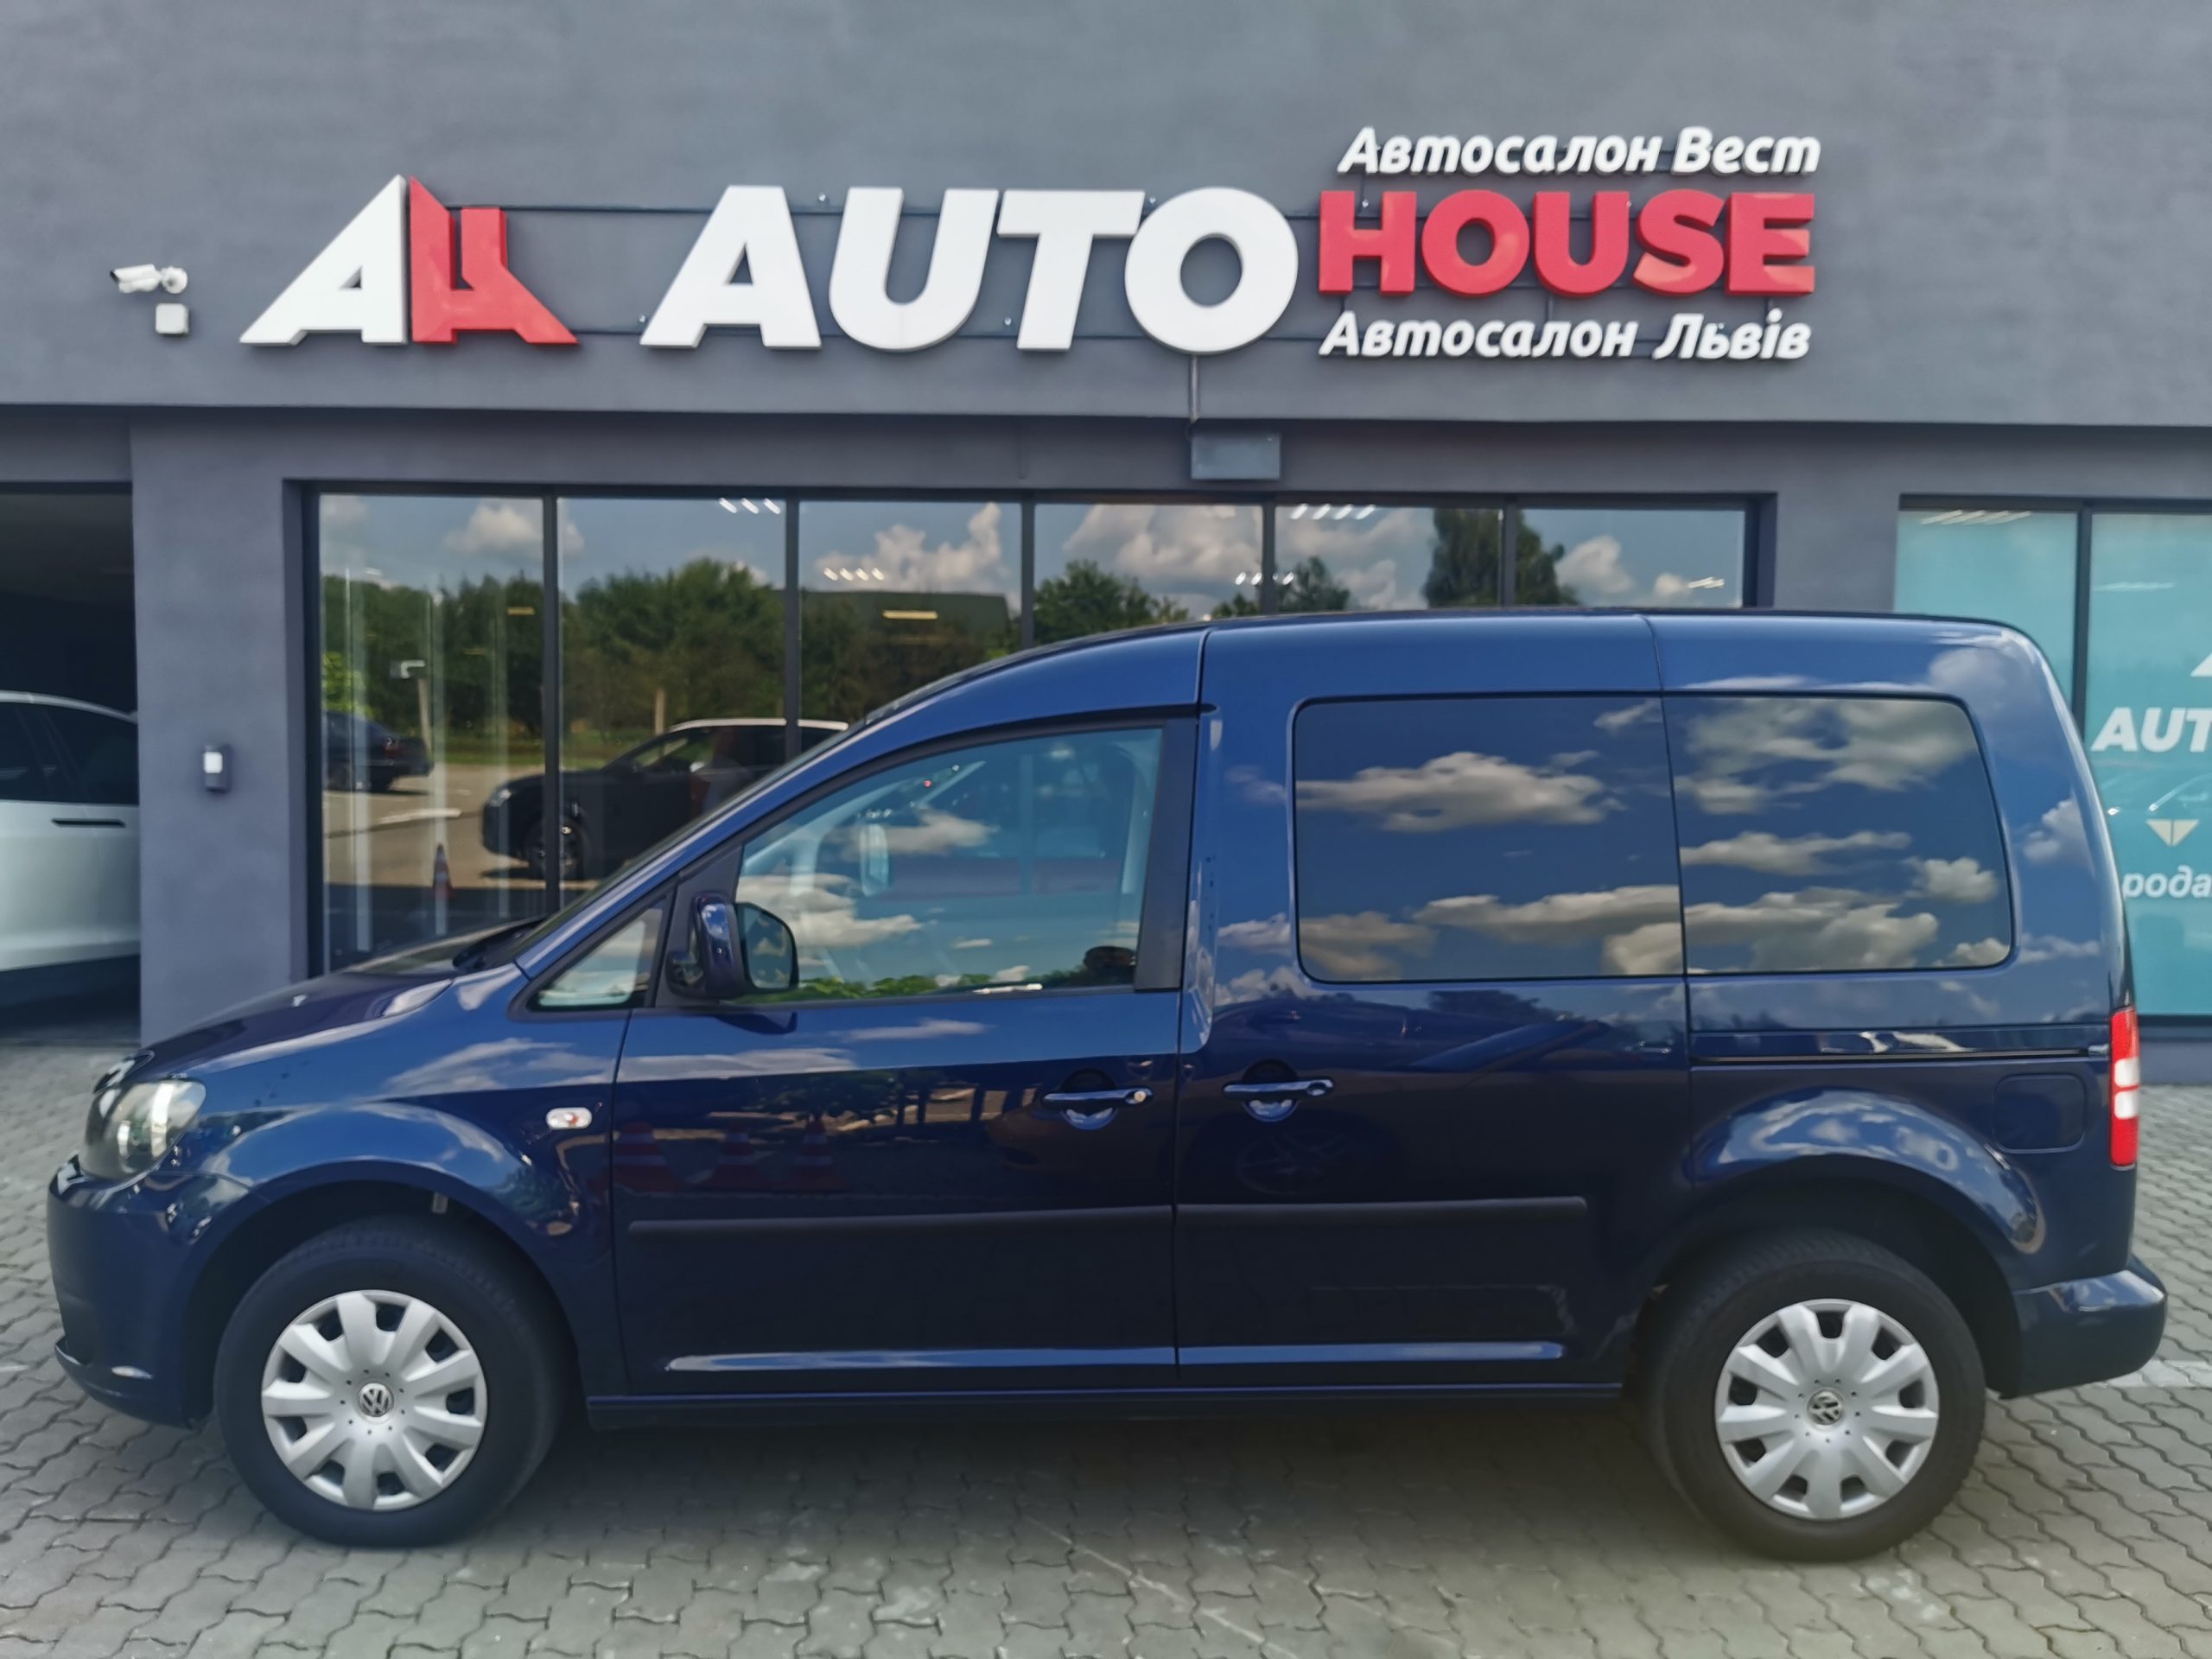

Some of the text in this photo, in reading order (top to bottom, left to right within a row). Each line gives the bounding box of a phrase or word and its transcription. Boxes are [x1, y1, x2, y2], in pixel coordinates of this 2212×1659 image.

[1337, 125, 1821, 174] Автосалон Вест
[639, 185, 1816, 353] AUTO HOUSE
[1319, 308, 1812, 360] Автосалон Львів
